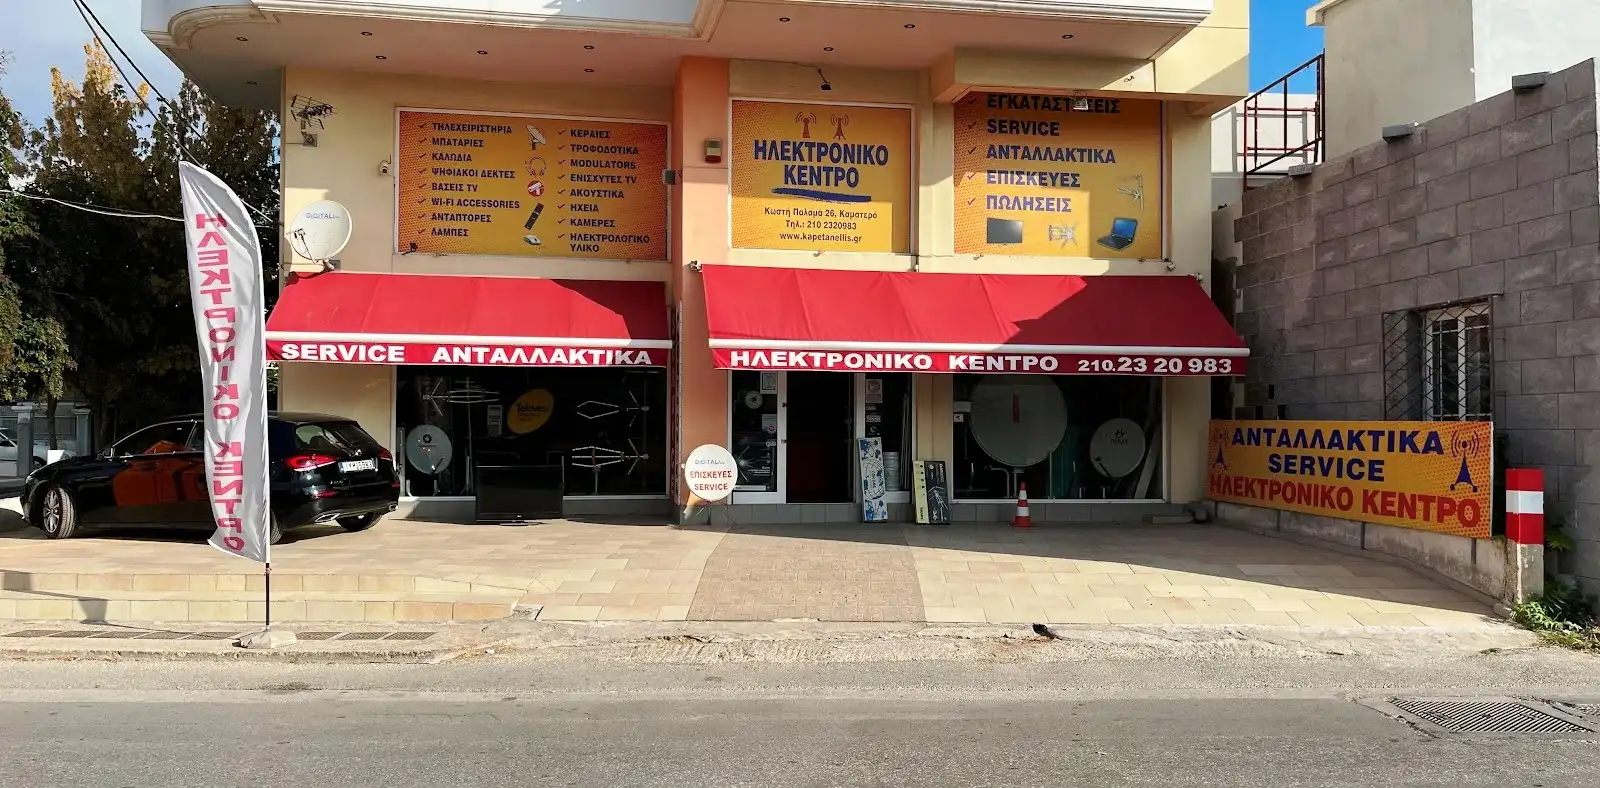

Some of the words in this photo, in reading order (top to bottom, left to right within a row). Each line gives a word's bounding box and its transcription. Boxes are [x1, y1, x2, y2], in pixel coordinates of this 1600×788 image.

[987, 93, 1120, 114] ΕΓΚΑΤΑΣΤΣΕΙΣ
[432, 122, 512, 134] ΤΗΛΕΧΕΙΡΙΣΤΗΡΙΑ
[986, 119, 1060, 136] SERVICE
[570, 130, 611, 139] ΚΕΡΑΙΕΣ
[432, 138, 484, 148] ΜΠΑΤΑΡΙΕΣ
[570, 144, 639, 155] ΤΡΟΦΟΔΟΤΙΚΑ
[754, 139, 889, 166] ΗΛΕΚΤΡΟΝΙΚΟ
[986, 144, 1116, 164] ΑΝΤΑΛΛΑΚΤΙΚΑ
[432, 153, 472, 162] ΚΑΛΩΔΙΑ
[570, 159, 636, 169] MODULATORS
[432, 168, 478, 177] ΨΗΦΙΑΚΟΙ
[481, 170, 515, 179] ΔΕΚΤΕΣ
[570, 174, 621, 184] ΕΝΙΣΧΥΤΕΣ
[625, 176, 637, 184] TV
[784, 165, 859, 188] ΚΕΝΤΡΟ
[986, 169, 1081, 188] ΕΠΙΣΚΕΥΕΣ
[432, 183, 464, 192] ΒΑΣΕΙΣ
[466, 184, 478, 192] TV
[570, 188, 624, 198] ΑΚΟΥΣΤΙΚΑ
[432, 198, 454, 206] WI-FI
[456, 199, 520, 209] ACCESSORIES
[570, 204, 599, 212] ΗΧΕΙΑ
[986, 195, 1072, 212] ΠΩΛΗΣΕΙΣ
[431, 213, 492, 223] ΑΝΤΑΠΤΟΡΕΣ
[825, 209, 837, 219] 26,
[570, 218, 615, 228] ΚΑΜΕΡΕΣ
[785, 220, 805, 230] Τηλ.:
[807, 220, 821, 229] 210
[823, 221, 857, 230] 2320983
[431, 228, 469, 237] ΛΑΜΠΕΣ
[570, 233, 650, 244] ΗΛΕΚΤΡΟΛΟΓΙΚΟ
[779, 233, 862, 244] www.kapetanellis.gr
[570, 244, 600, 253] ΥΛΙΚΟ
[281, 343, 405, 362] SERVICE
[432, 346, 652, 365] ΑΝΤΑΛΛΑΚΤΙΚΑ
[730, 351, 933, 370] ΗΛΕΚΤΡΟΝΙΚΟ
[948, 355, 1058, 371] ΚΕΝΤΡΟ
[1153, 358, 1183, 373] 20
[1187, 358, 1232, 373] 983
[1231, 427, 1444, 455] ΑΝΤΑΛΛΑΚΤΙΚΑ
[1268, 453, 1385, 482] SERVICE
[690, 470, 732, 479] ΕΠΙΣΚΕΥΕΣ
[694, 483, 729, 491] SERVICE
[1210, 474, 1354, 512] ΗΛΕΚΤΡΟΝΙΚΟ
[1362, 489, 1481, 528] ΚΕΝΤΡΟ
